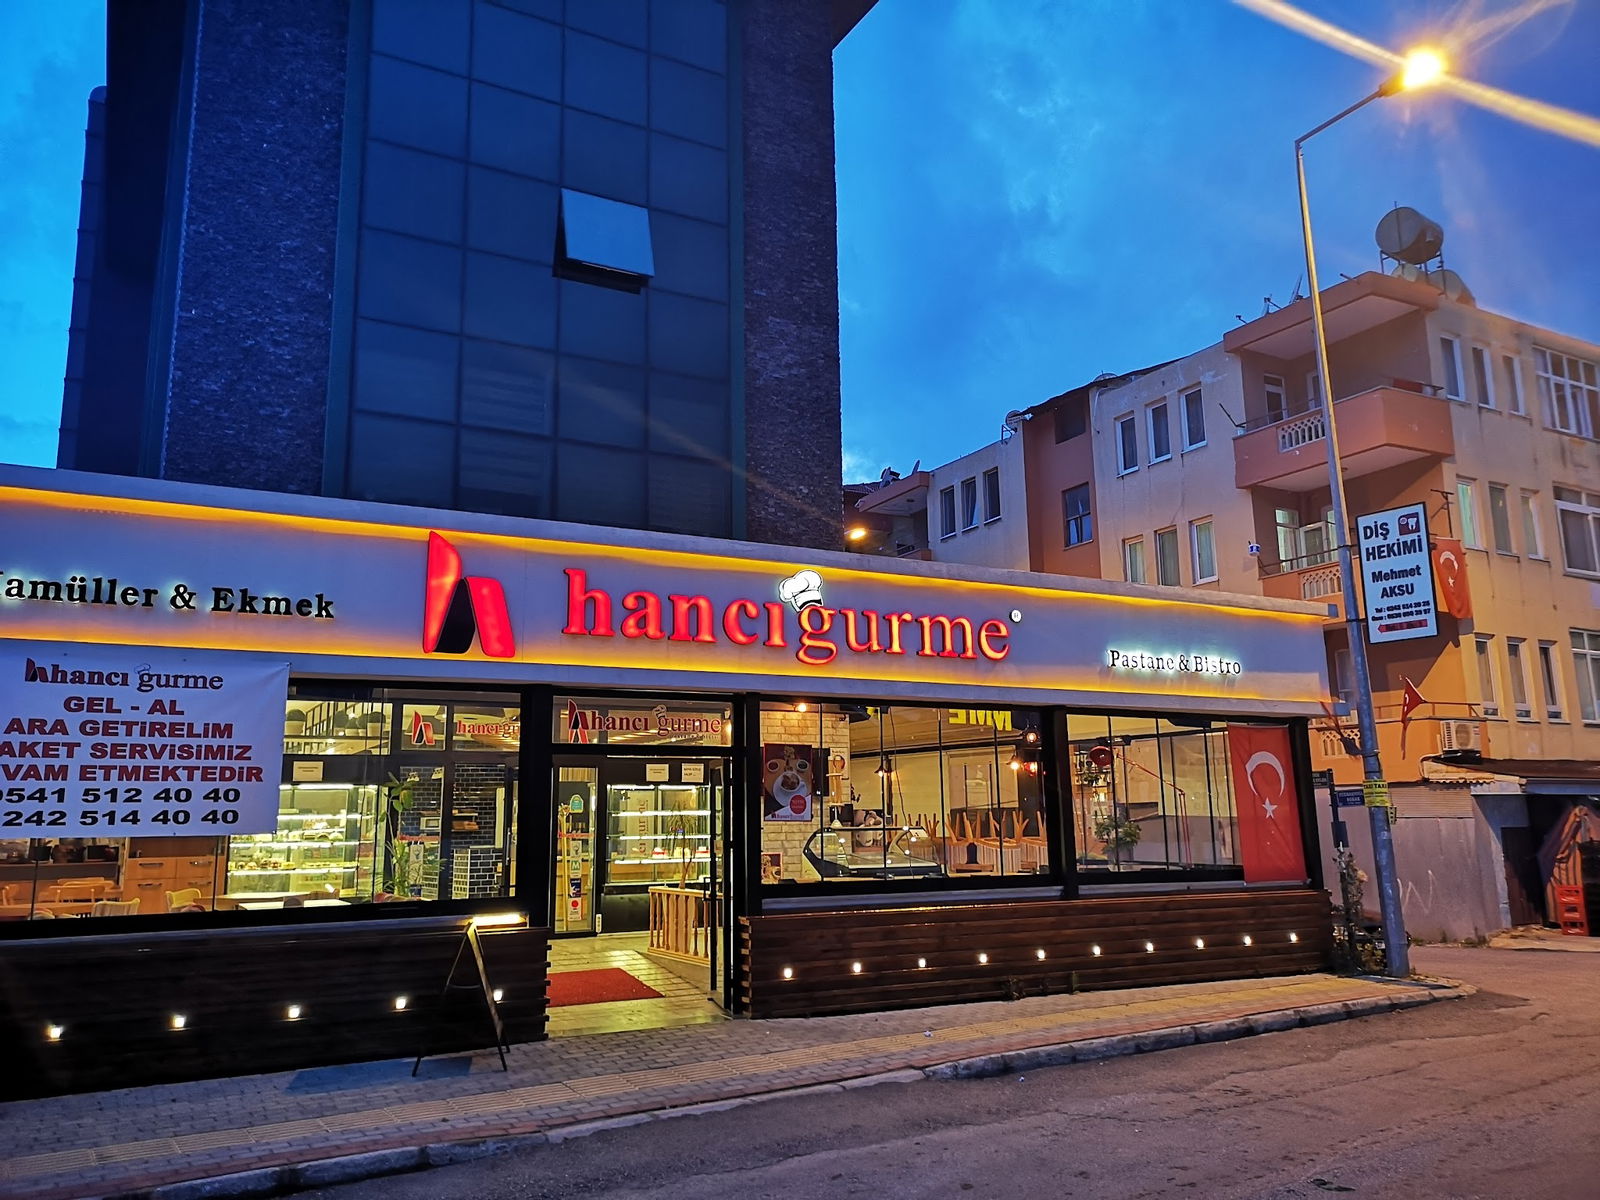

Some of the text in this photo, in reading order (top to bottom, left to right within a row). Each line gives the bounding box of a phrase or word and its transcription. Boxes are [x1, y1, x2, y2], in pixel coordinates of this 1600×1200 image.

[1363, 521, 1390, 540] DİŞ
[1366, 535, 1423, 561] HEKİMİ
[1371, 565, 1421, 583] Mehmet
[0, 571, 335, 619] amüller & Ekmek
[1380, 583, 1414, 599] AKSU
[562, 568, 1010, 665] hancı gurme
[1109, 650, 1241, 674] Pastane & Bistro
[136, 673, 224, 693] gurme
[63, 696, 122, 714] GEL
[147, 699, 184, 716] AL
[4, 718, 69, 736] ARA
[657, 716, 721, 737] gurme
[82, 787, 142, 803] 512
[153, 787, 192, 803] 40
[202, 787, 241, 803] 40
[2, 809, 239, 827] 242 514 40 40
